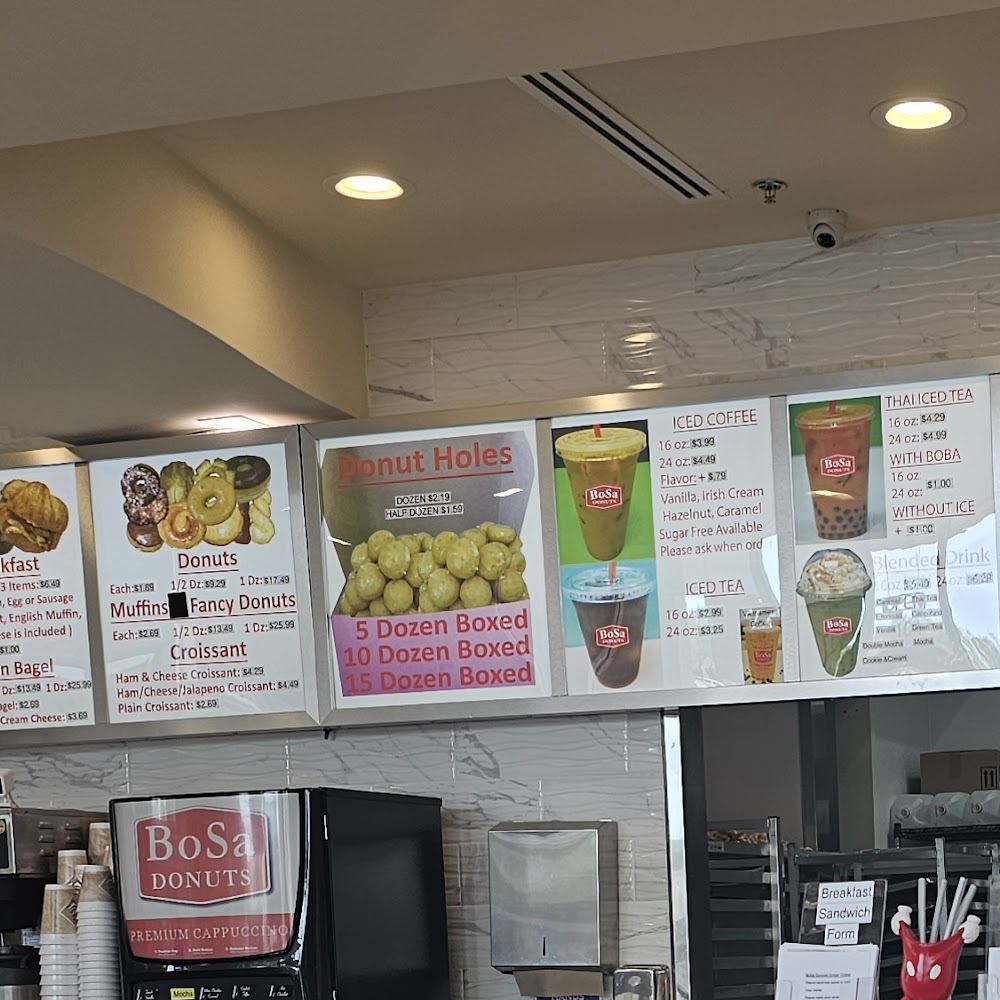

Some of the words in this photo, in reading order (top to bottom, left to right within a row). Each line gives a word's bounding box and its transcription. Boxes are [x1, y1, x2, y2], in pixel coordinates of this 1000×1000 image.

[885, 394, 915, 408] THAI
[918, 390, 947, 405] ICED
[949, 388, 974, 401] TEA
[673, 414, 703, 430] ICED
[706, 408, 758, 426] COFFEE
[337, 450, 424, 479] Donut
[433, 441, 513, 471] Holes
[890, 451, 923, 465] WITH
[926, 448, 961, 462] BOBA
[661, 474, 697, 486] Flavor:
[396, 494, 426, 505] DOZEN
[590, 488, 619, 500] BoSa
[661, 491, 700, 505] Vanilla,
[702, 489, 726, 501] Irish
[728, 487, 764, 499] Cream
[663, 508, 715, 522] Hazelnut,
[716, 503, 762, 517] Caramel
[892, 501, 953, 519] WITHOUT
[956, 500, 975, 513] ICE
[659, 528, 689, 542] Sugar
[691, 525, 713, 537] Free
[716, 521, 763, 535] Available
[660, 544, 692, 557] Please
[714, 540, 743, 552] when
[947, 547, 991, 565] Drink
[177, 550, 238, 569] Donuts
[8, 580, 40, 592] Items:
[264, 575, 290, 585] $17.49
[686, 581, 716, 596] ICED
[719, 579, 745, 593] TEA
[37, 593, 74, 605] Sausage
[110, 598, 169, 618] Muffins
[190, 597, 234, 615] Fancy
[239, 594, 296, 610] Donuts
[9, 612, 43, 625] English
[46, 609, 83, 621] Muffin,
[356, 620, 369, 640] 5
[377, 618, 448, 637] Dozen
[456, 608, 528, 633] Boxed
[24, 625, 66, 638] included
[113, 630, 138, 641] Each:
[170, 641, 248, 660] Croissant
[344, 647, 371, 667] 10
[379, 644, 450, 664] Dozen
[458, 635, 530, 659] Boxed
[14, 658, 54, 677] Bagel
[116, 672, 139, 684] Ham
[152, 670, 188, 682] Cheese
[190, 667, 240, 680] Croissant:
[346, 673, 372, 693] 15
[381, 671, 451, 691] Dozen
[459, 662, 532, 686] Boxed
[117, 683, 225, 699] Ham/Cheese/Jalapeno
[228, 681, 276, 693] Croissant:
[118, 702, 143, 714] Plain
[145, 700, 194, 712] Croissant:
[0, 715, 29, 725] Cream
[31, 713, 66, 723] Cheese:
[145, 821, 255, 862] BoSa
[151, 868, 251, 890] DONUTS
[821, 885, 872, 900] Breakfast
[818, 906, 871, 920] Sandwich
[130, 928, 189, 943] PREMIUM
[193, 924, 289, 939] CAPPUCCINO
[826, 927, 855, 940] Form
[173, 990, 194, 999] Mocha
